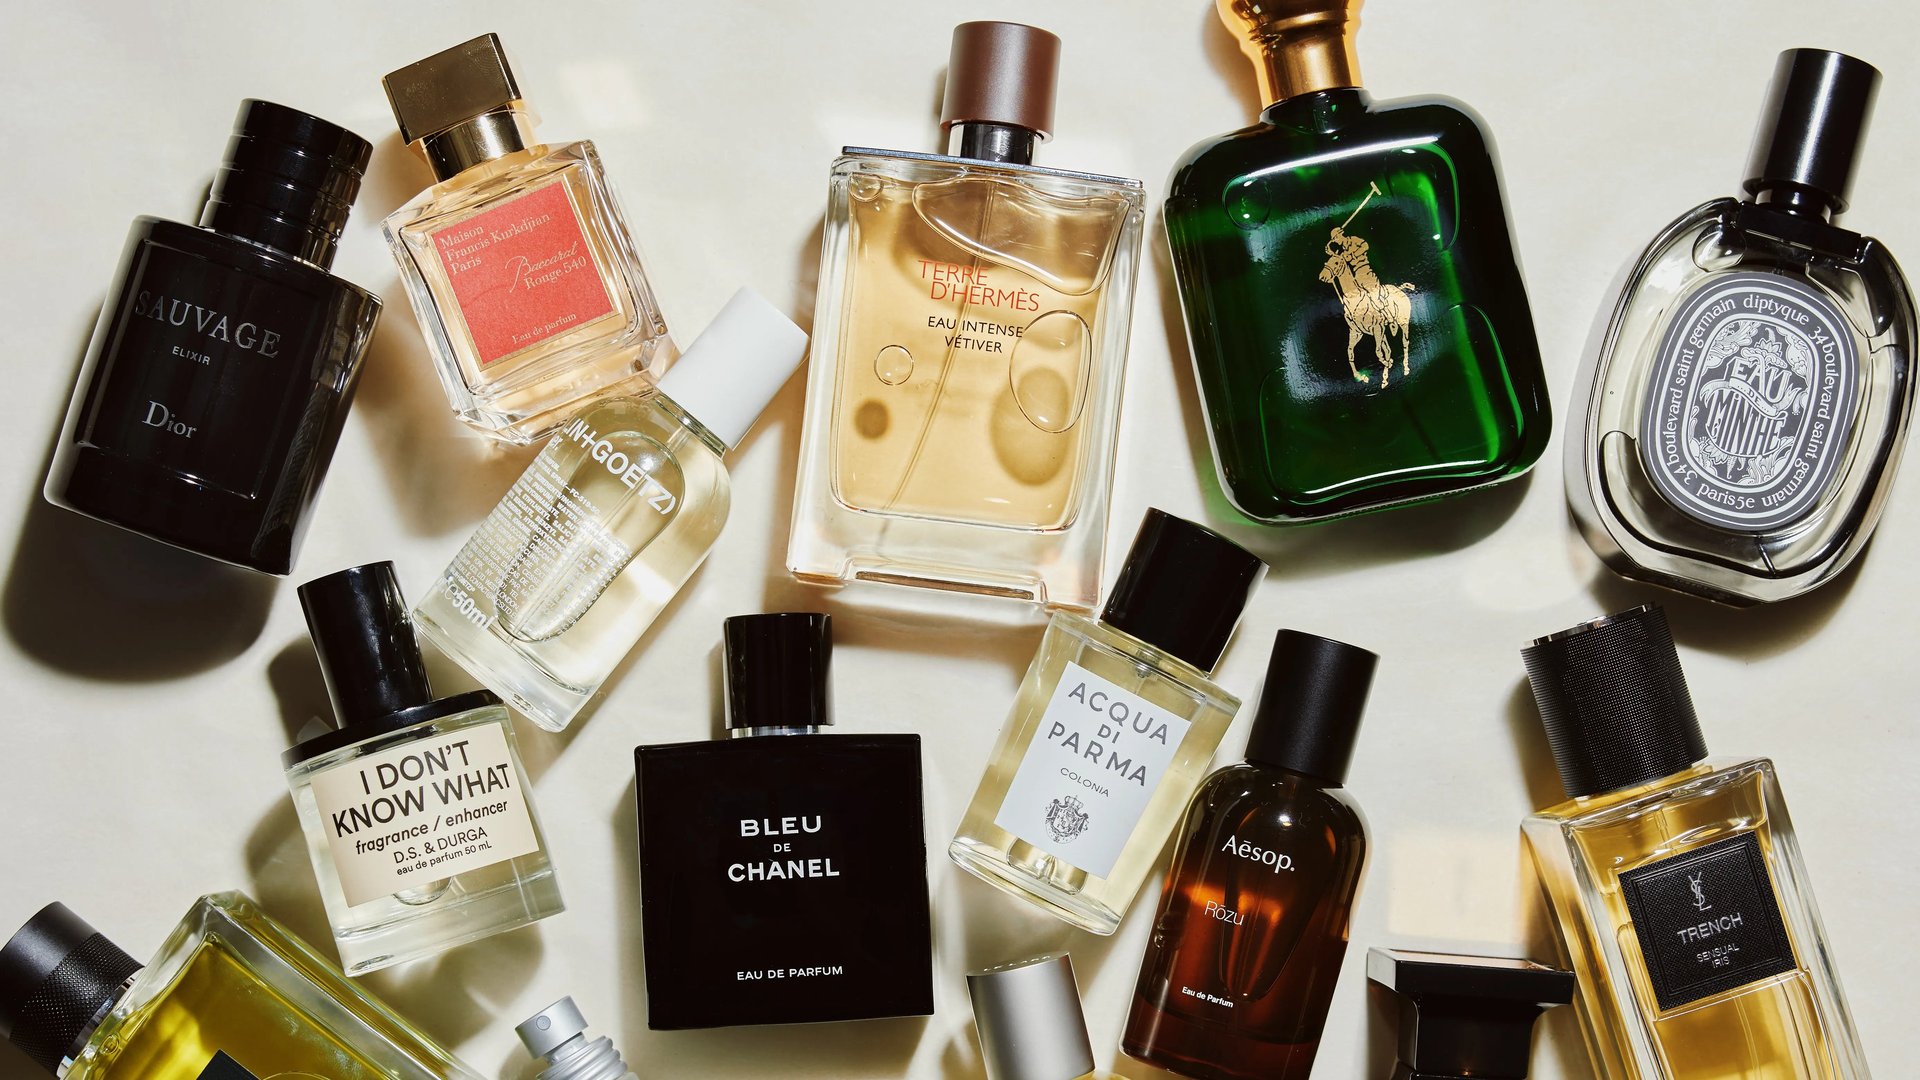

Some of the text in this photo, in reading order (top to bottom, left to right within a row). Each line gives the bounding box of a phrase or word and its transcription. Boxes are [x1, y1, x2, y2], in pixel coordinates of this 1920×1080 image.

[439, 224, 484, 250] Maison
[445, 212, 550, 262] Francis Kurkdjian
[451, 256, 482, 275] Paris
[505, 240, 578, 293] Baccarat
[523, 257, 587, 290] Rouge 540
[917, 259, 989, 287] TERRE
[930, 281, 1040, 312] D'HERMÈS
[1743, 294, 1810, 326] diptyque
[135, 290, 281, 359] SAUVAGE
[512, 312, 577, 346] Eau de parfum
[928, 316, 1024, 338] EAU INTENSE
[172, 346, 211, 366] ELIXIR
[944, 334, 1003, 353] VÉTIVER
[1662, 296, 1736, 486] 34 boulevard saint germain
[1731, 356, 1792, 403] EAU
[142, 400, 198, 439] Dior
[1706, 384, 1787, 457] MINTHE
[1811, 421, 1825, 459] saint
[1762, 457, 1810, 507] germain
[1068, 682, 1168, 745] ACQUA
[1097, 723, 1120, 744] DI
[1048, 721, 1147, 786] PARMA
[360, 770, 371, 795] I
[1060, 767, 1109, 797] COLONIA
[332, 763, 511, 838] KNOW WHAT
[356, 822, 429, 855] fragrance
[446, 801, 508, 827] enhancer
[740, 815, 822, 837] BLEU
[393, 826, 488, 864] D.S. & DURGA
[396, 840, 493, 876] eau de parfum 50 mL
[773, 843, 792, 853] DE
[727, 858, 840, 882] CHANEL
[1677, 912, 1744, 944] TRENCH
[1696, 943, 1740, 963] SENSUAL
[1711, 956, 1730, 969] IRIS
[736, 966, 843, 981] EAU DE PARFUM
[1181, 986, 1234, 1008] Eau de Parfum
